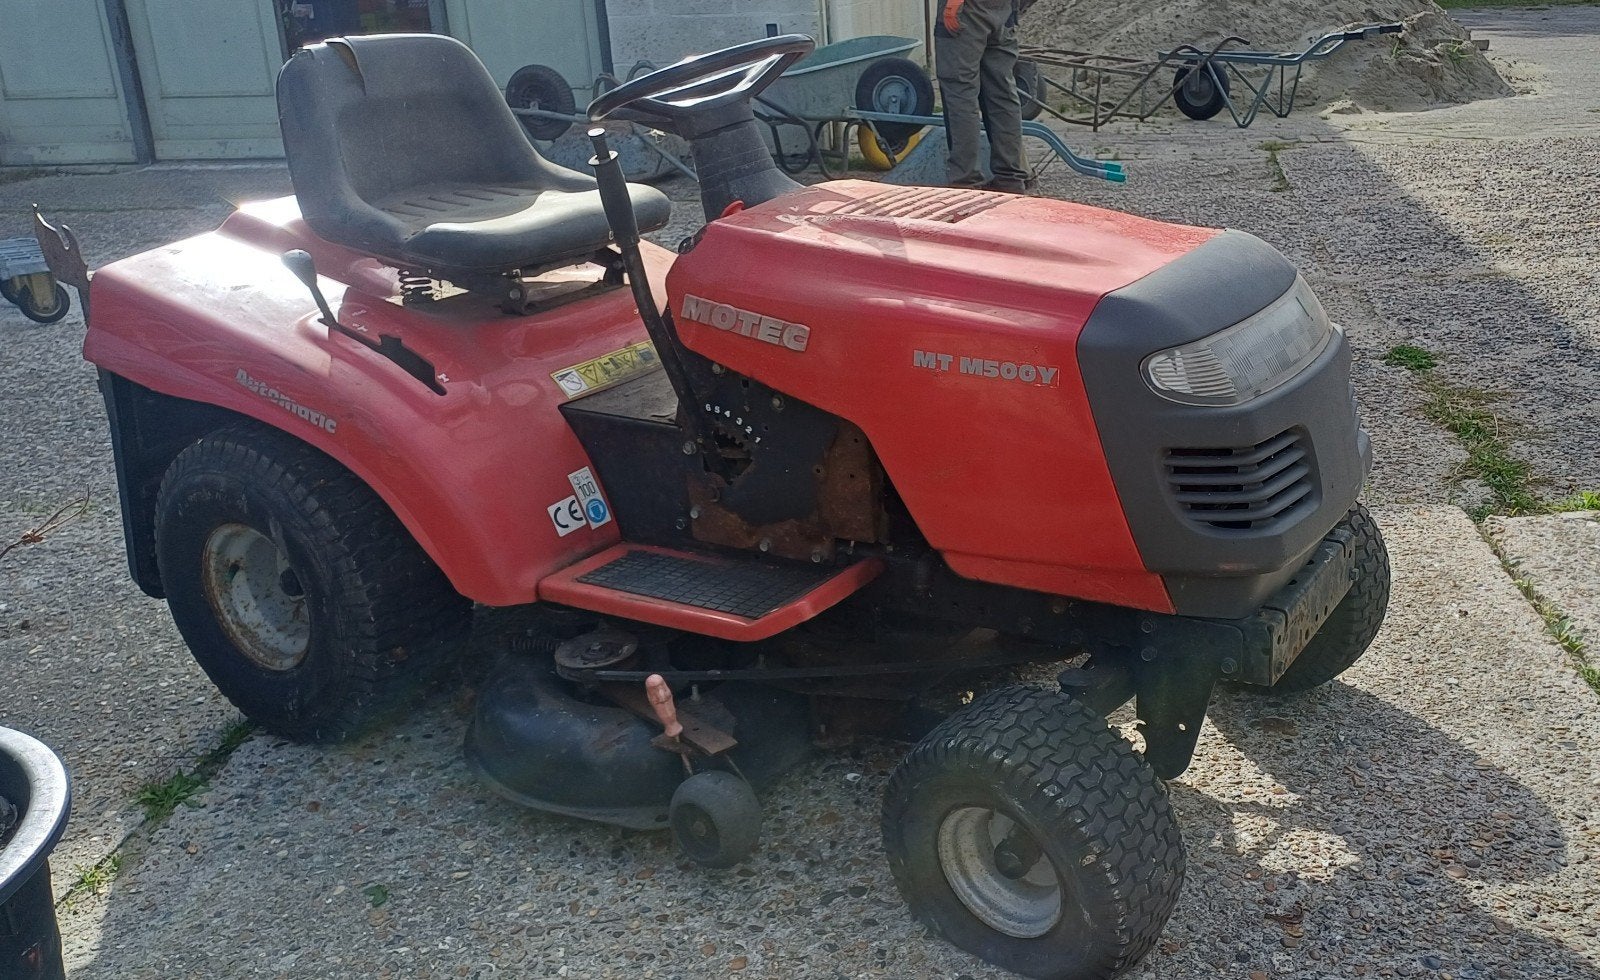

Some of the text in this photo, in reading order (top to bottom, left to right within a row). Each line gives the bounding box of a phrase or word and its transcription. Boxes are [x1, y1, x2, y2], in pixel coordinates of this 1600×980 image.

[681, 294, 811, 351] MOTEC
[913, 349, 1057, 384] MT M500Y
[705, 403, 712, 412] 6
[724, 410, 731, 418] 4
[735, 417, 743, 426] 3
[744, 425, 753, 435] 2
[754, 436, 761, 444] 1
[578, 481, 597, 499] 100
[553, 499, 584, 529] CE
